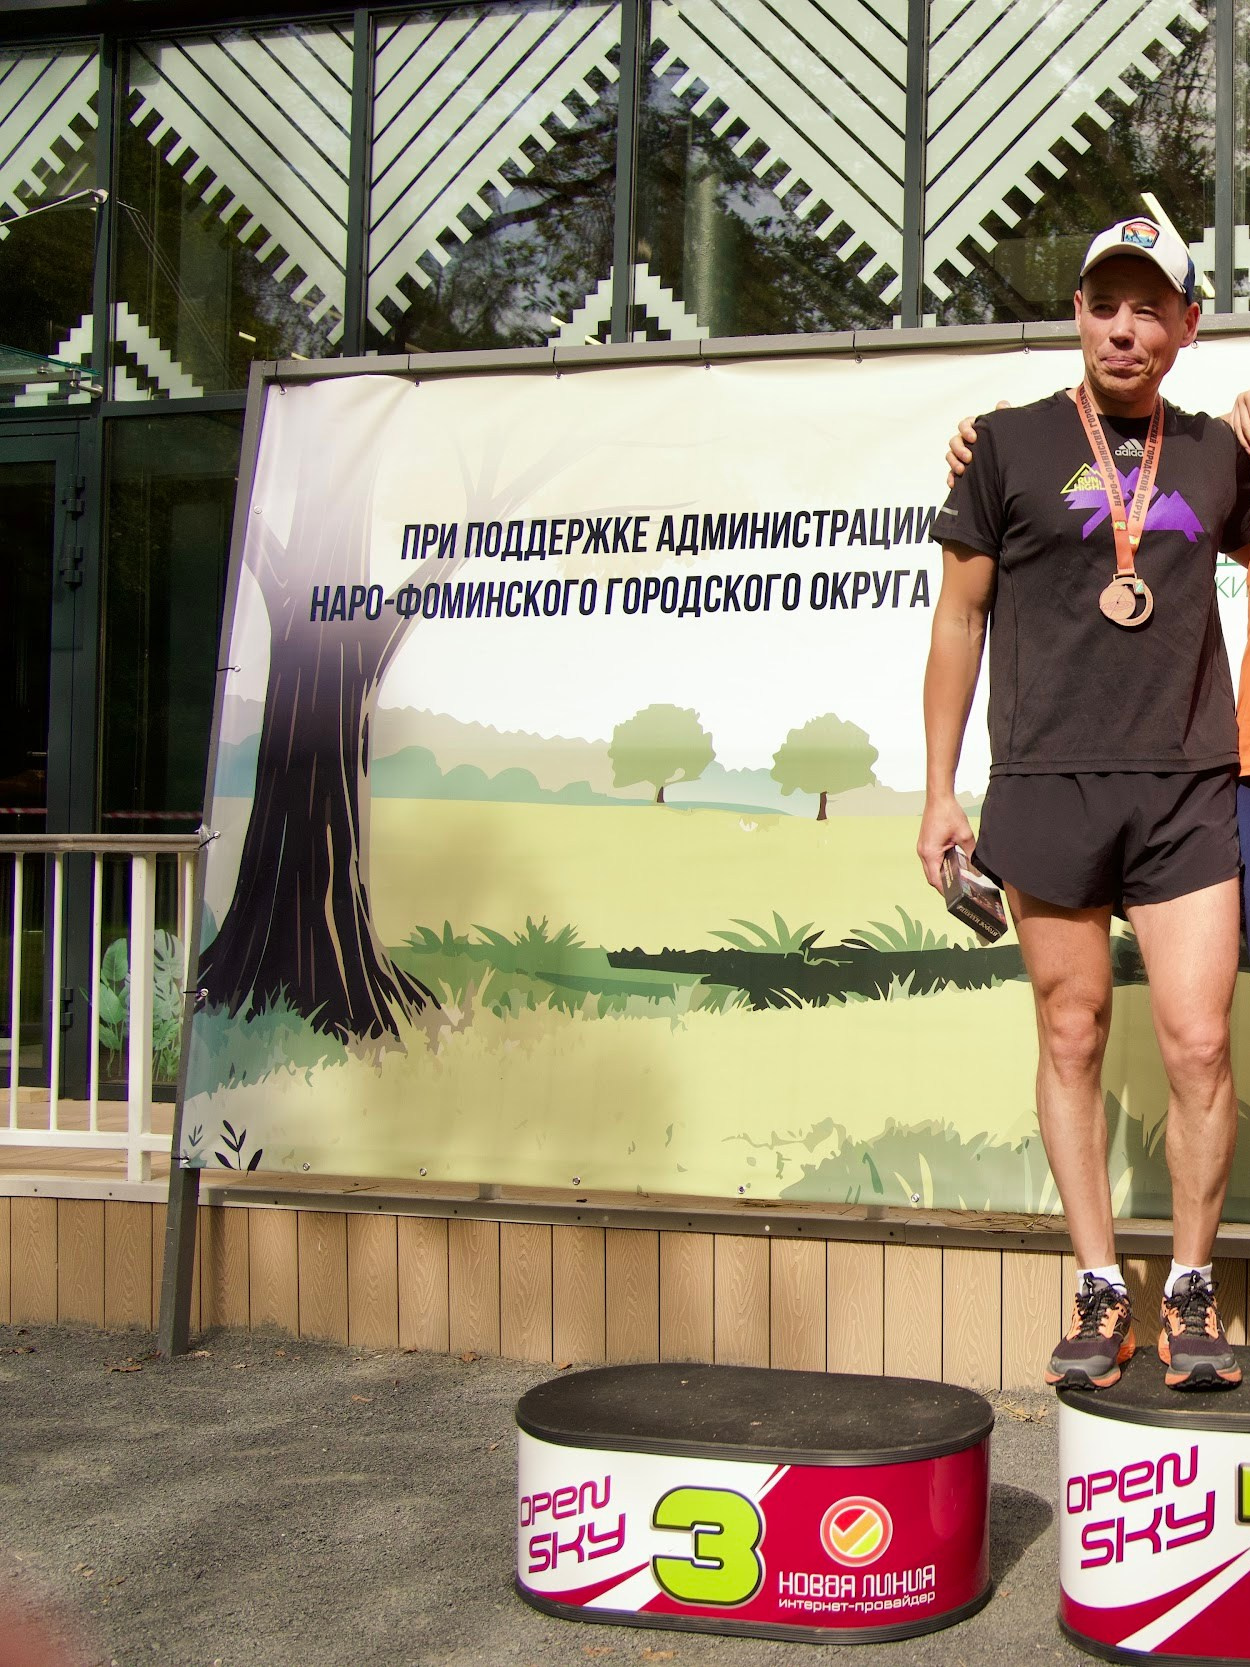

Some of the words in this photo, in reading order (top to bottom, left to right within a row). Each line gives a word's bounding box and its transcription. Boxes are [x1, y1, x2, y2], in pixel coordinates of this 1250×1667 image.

[1115, 449, 1144, 457] adida
[1139, 446, 1156, 491] ГОРОДСКОЙ
[1077, 476, 1098, 485] RUN
[1132, 493, 1146, 522] ОКРУГ
[401, 523, 458, 560] ПРИ
[464, 515, 650, 561] ПОДДЕРЖКЕ
[655, 505, 937, 556] АДМИНИСТРАЦИИ
[310, 578, 598, 622] НАРО-ФОМИНСКОГО
[605, 573, 801, 618] ГОРОДСКОГО
[809, 569, 930, 610] ОКРУГА
[528, 1512, 627, 1574] SKY
[650, 1485, 767, 1608] 3
[1080, 1490, 1216, 1570] SKY
[778, 1570, 857, 1599] НОВАЯ
[862, 1564, 936, 1598] ЛИНИЯ
[778, 1590, 936, 1613] интернет-провайдер
